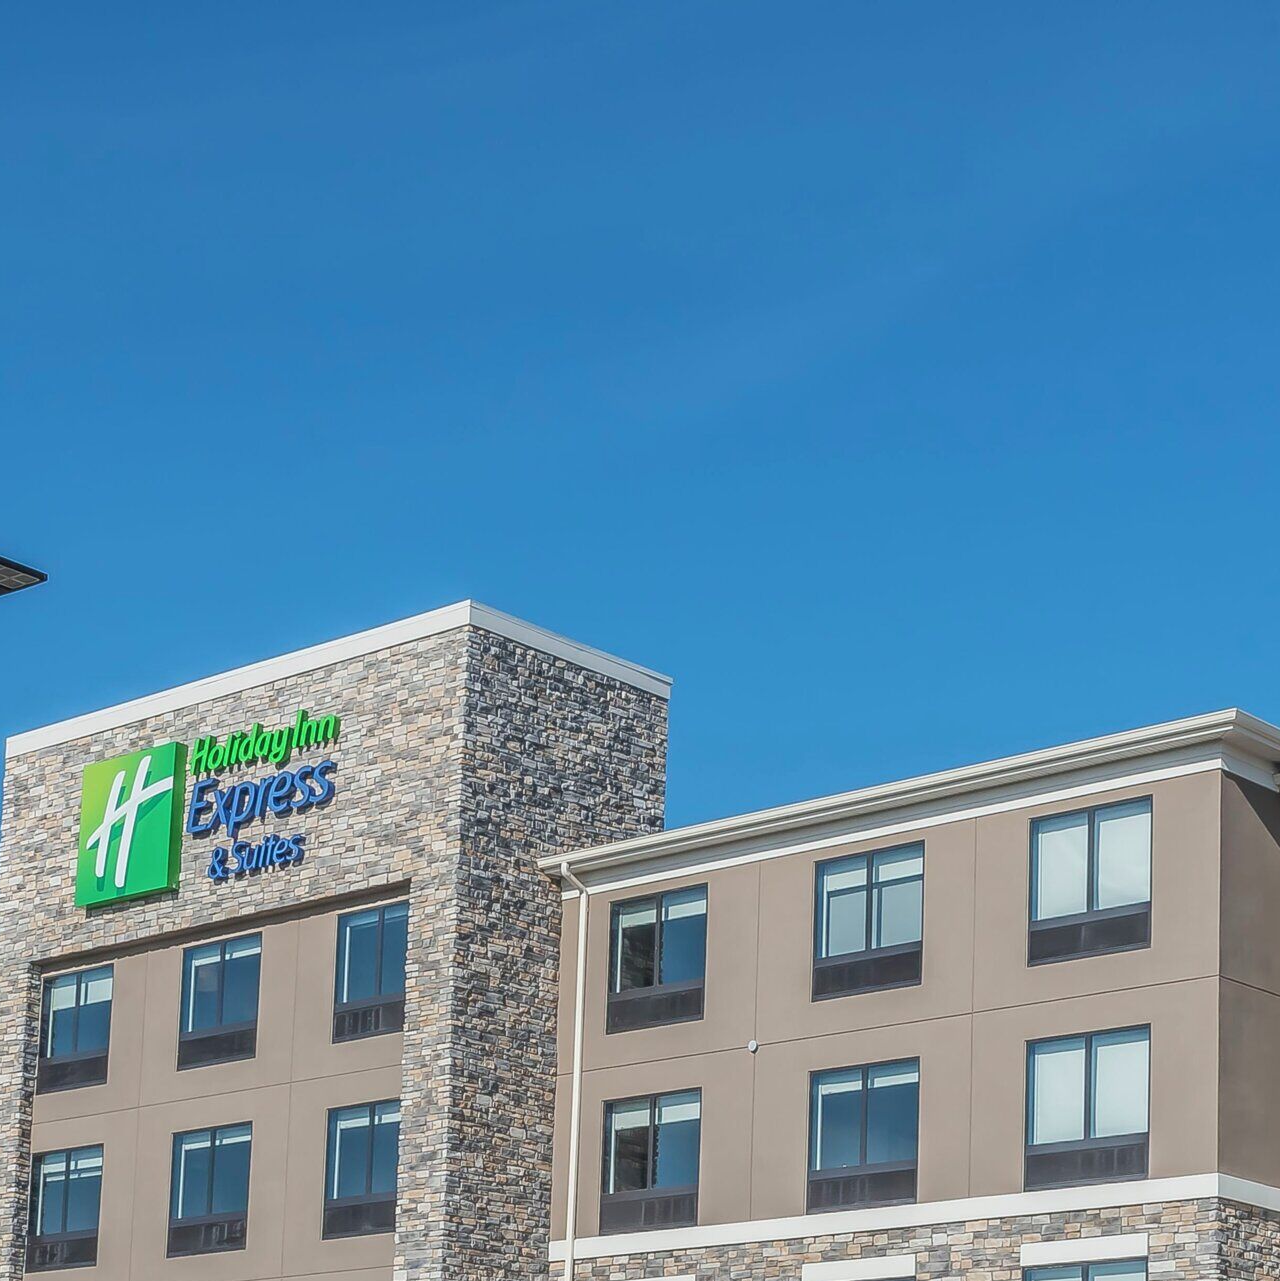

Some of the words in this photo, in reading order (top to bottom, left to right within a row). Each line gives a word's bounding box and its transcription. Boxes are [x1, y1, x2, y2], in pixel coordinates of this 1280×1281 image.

[189, 722, 288, 775] Holiday
[291, 709, 338, 747] Inn
[186, 760, 336, 837] Express
[207, 846, 228, 880] &
[231, 832, 305, 872] Suites
